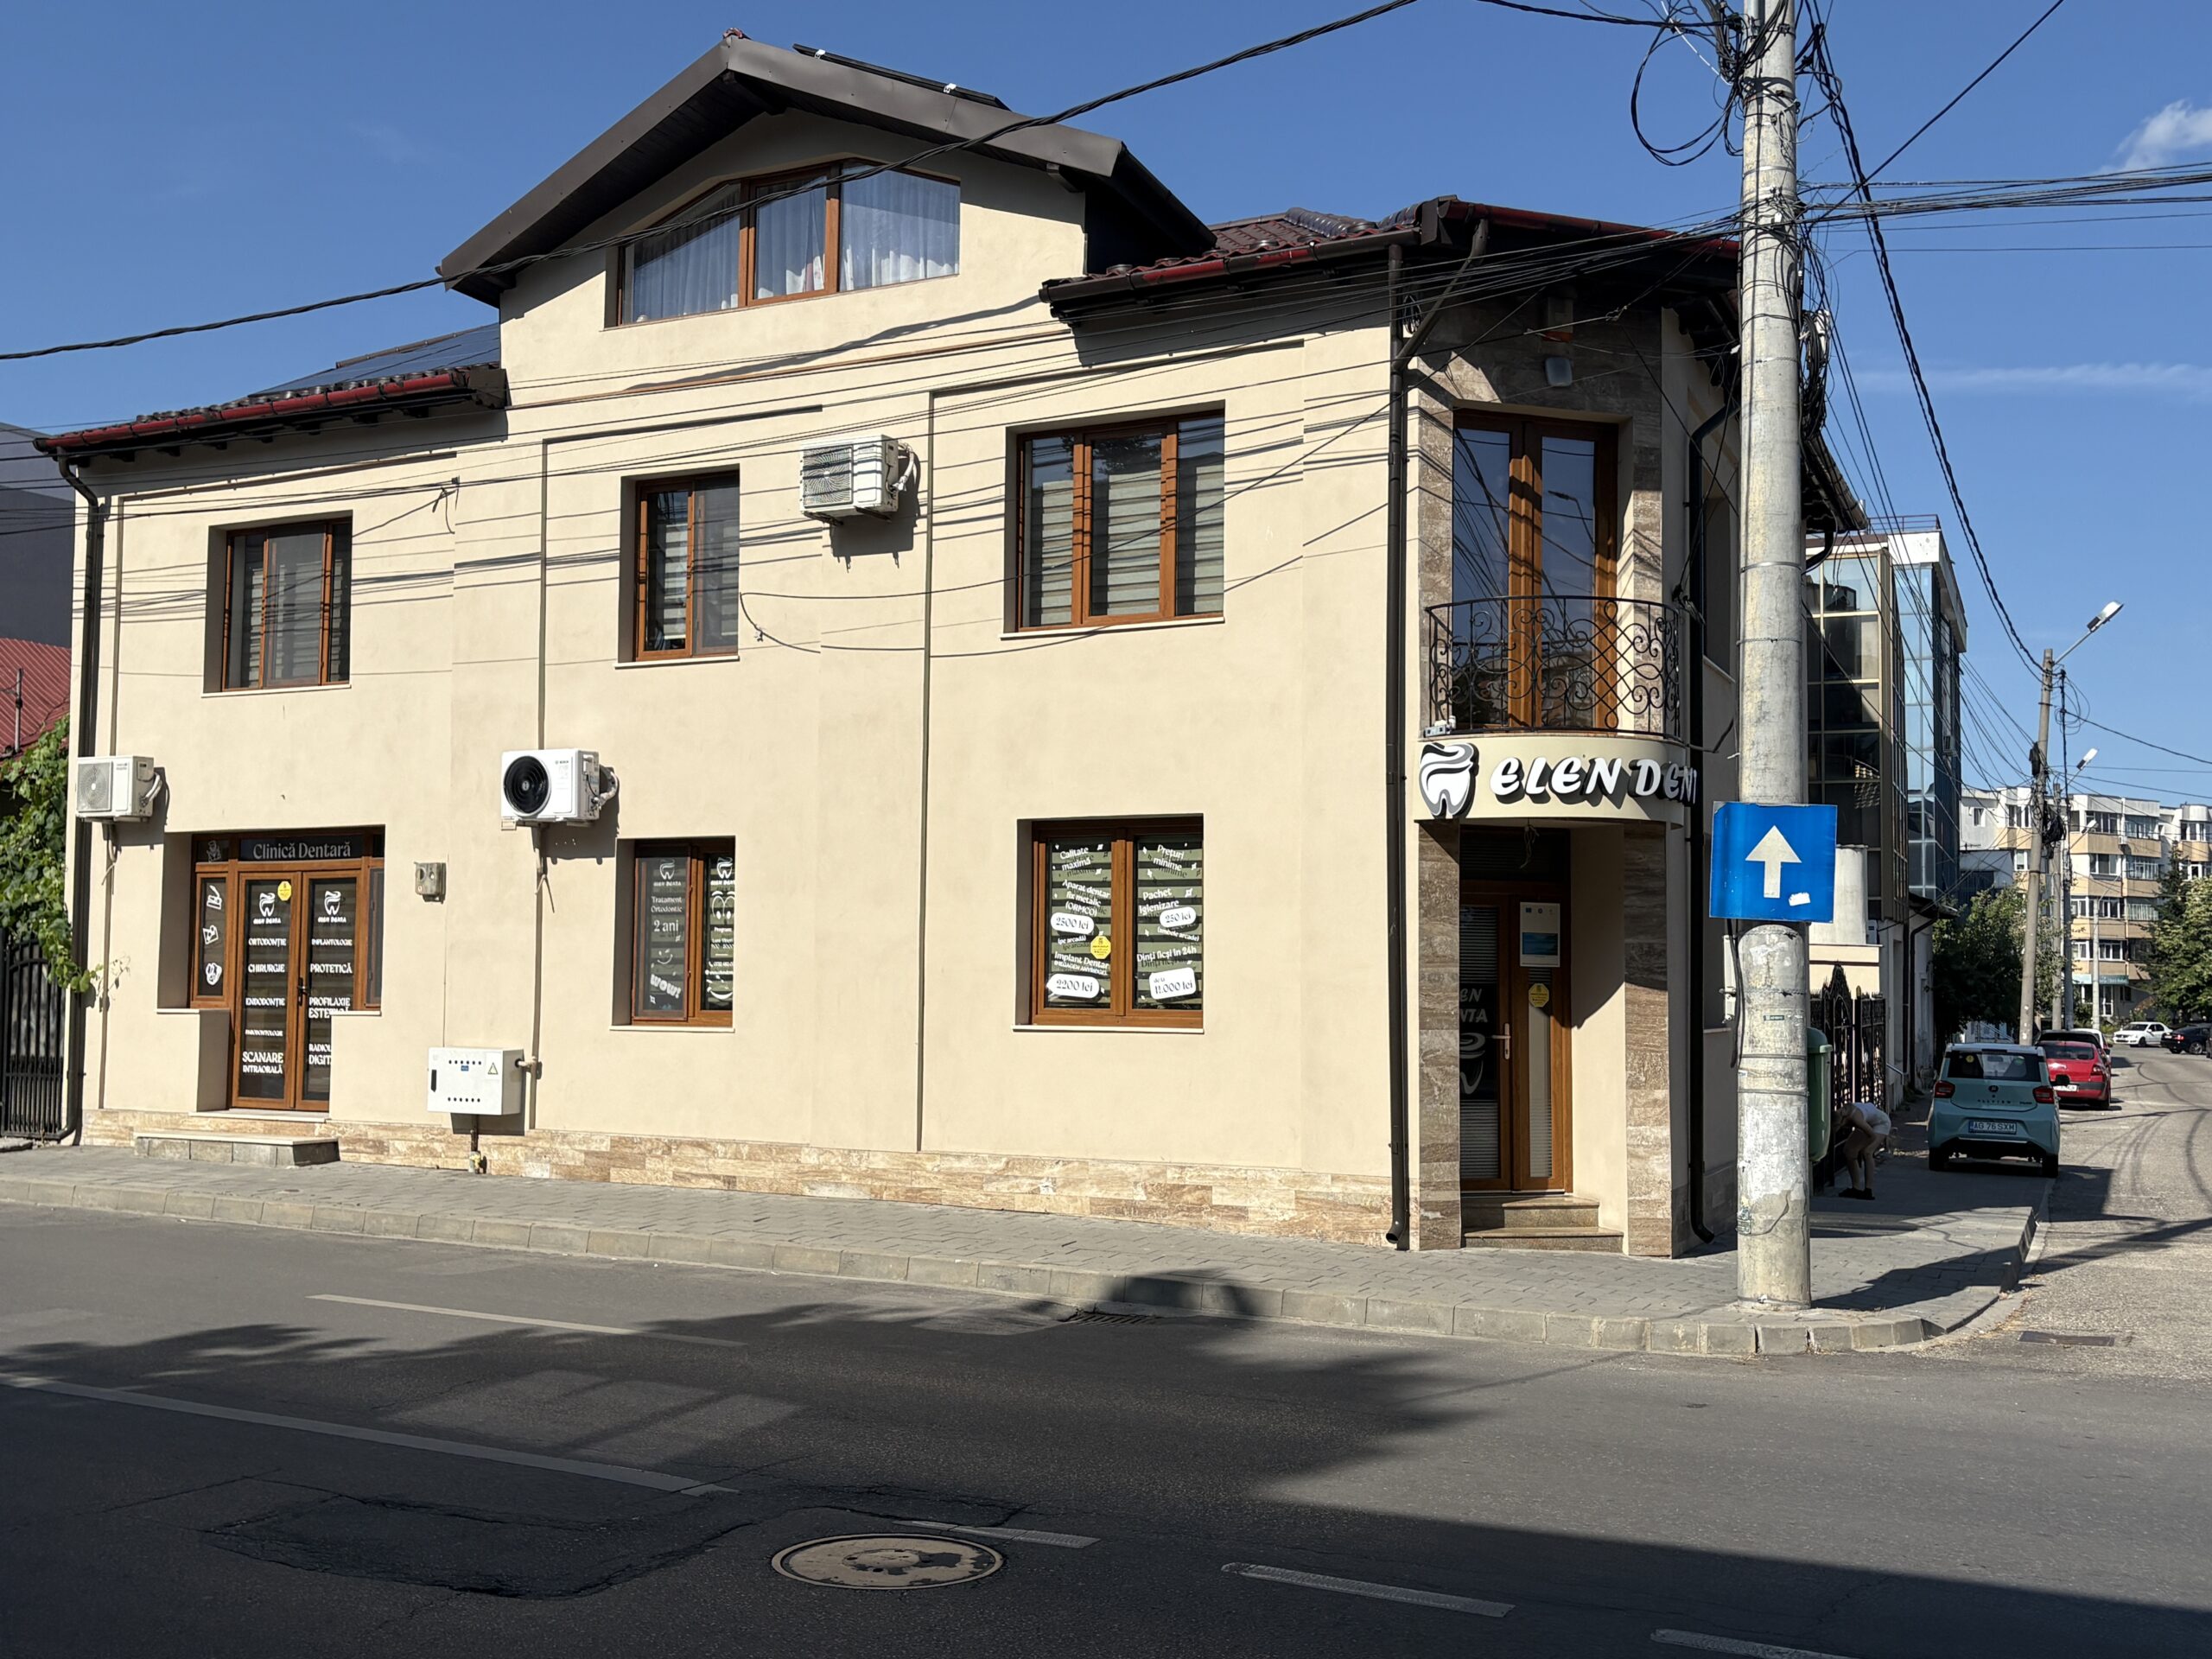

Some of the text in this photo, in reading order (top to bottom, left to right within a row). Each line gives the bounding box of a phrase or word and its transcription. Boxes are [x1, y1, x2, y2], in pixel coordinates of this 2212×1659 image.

[1490, 756, 1698, 804] ELEN DEN
[253, 842, 351, 860] Clinică Dentară
[1059, 847, 1089, 860] Calitate
[1157, 843, 1185, 860] Prețuri
[1061, 857, 1091, 871] maximă
[1153, 857, 1182, 872] minime
[1062, 879, 1110, 899] Aparat dentar
[1142, 887, 1173, 901] Pachet
[1075, 893, 1102, 907] metalic
[651, 905, 683, 913] Ortodontic
[1138, 899, 1179, 916] Igienizare
[1055, 917, 1090, 930] 2500 lei
[1165, 912, 1192, 924] 250 lei
[653, 919, 679, 932] 2 ani
[1181, 944, 1197, 956] 24h
[1054, 951, 1110, 969] Implant Dentar
[248, 963, 285, 973] CHIRURGIE
[309, 963, 353, 974] PROTETICĂ
[650, 974, 682, 999] WOW!
[1056, 978, 1094, 993] 2200 lei
[1182, 980, 1193, 990] lei
[308, 997, 351, 1007] PROFILAXIE
[242, 1052, 283, 1064] SCANARE
[308, 1054, 331, 1065] DIGIT
[1987, 1122, 1997, 1130] 76
